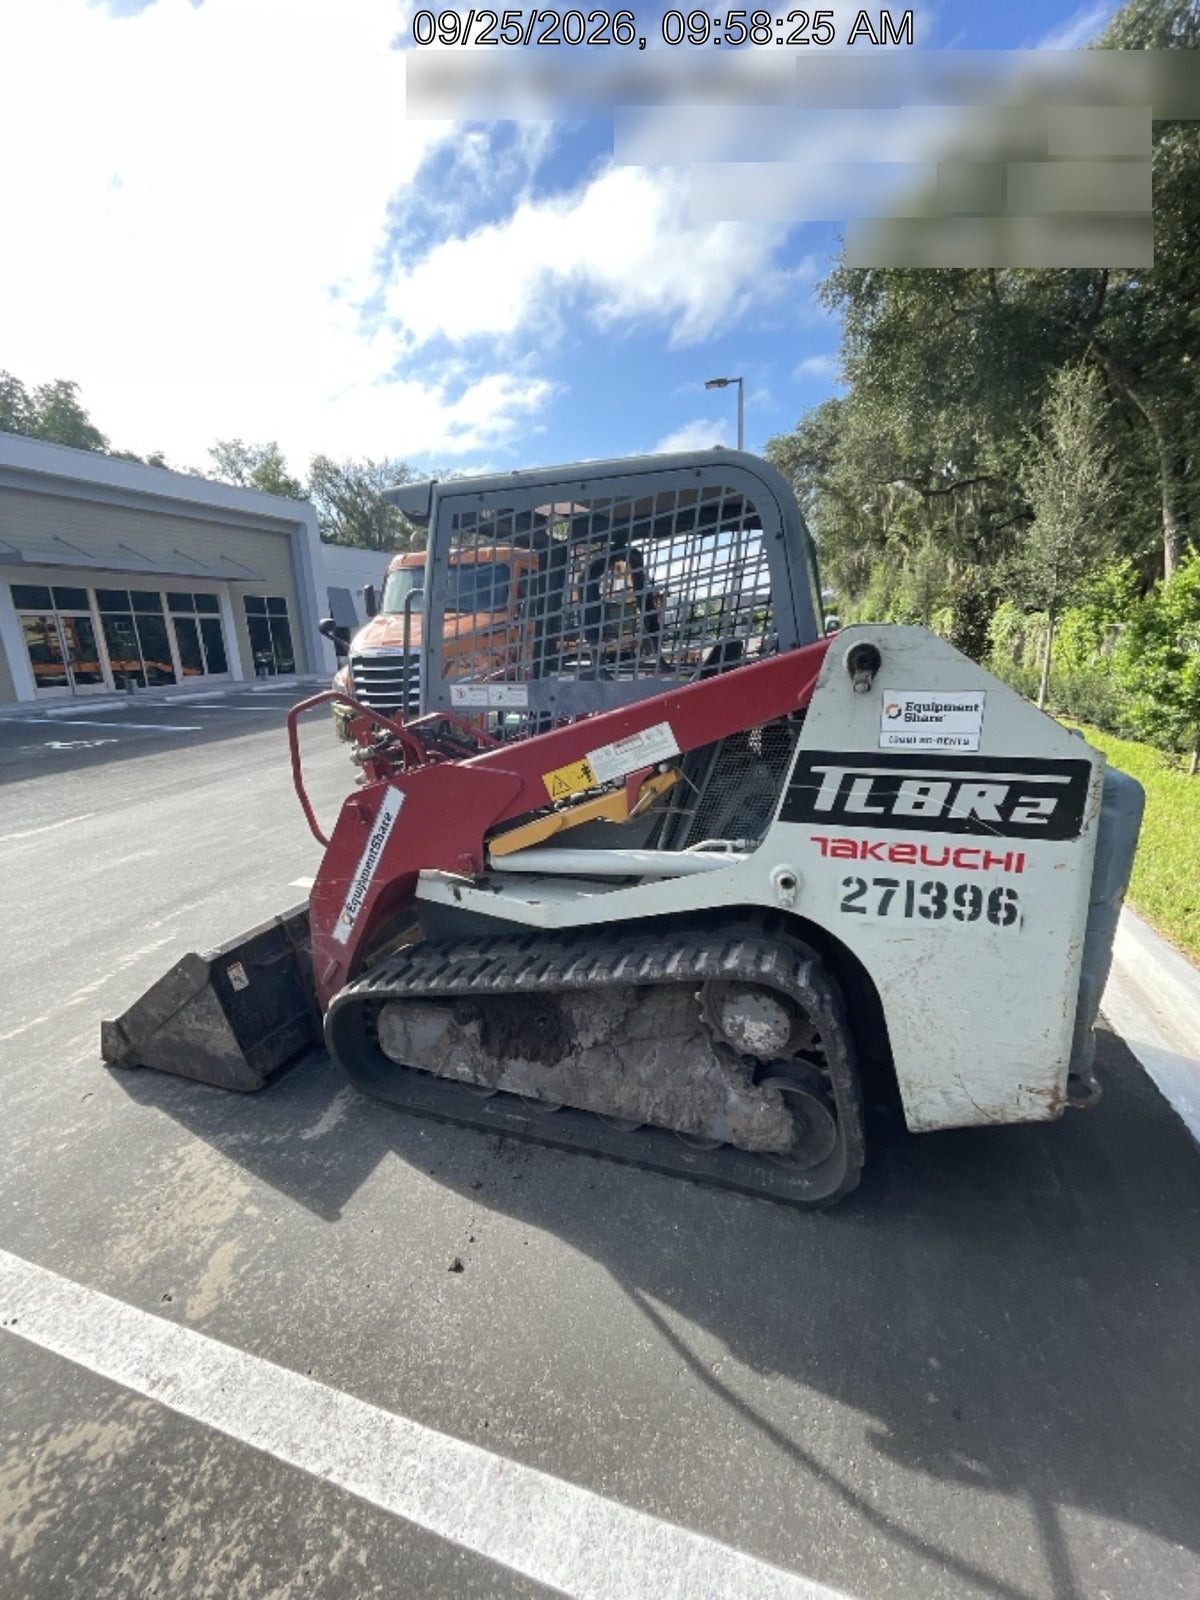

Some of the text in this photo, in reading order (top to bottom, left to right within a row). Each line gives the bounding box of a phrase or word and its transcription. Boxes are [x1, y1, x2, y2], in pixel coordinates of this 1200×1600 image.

[904, 701, 979, 713] Equipment
[904, 713, 943, 723] Share
[810, 765, 1072, 824] TL8R2
[840, 876, 1019, 926] 271396
